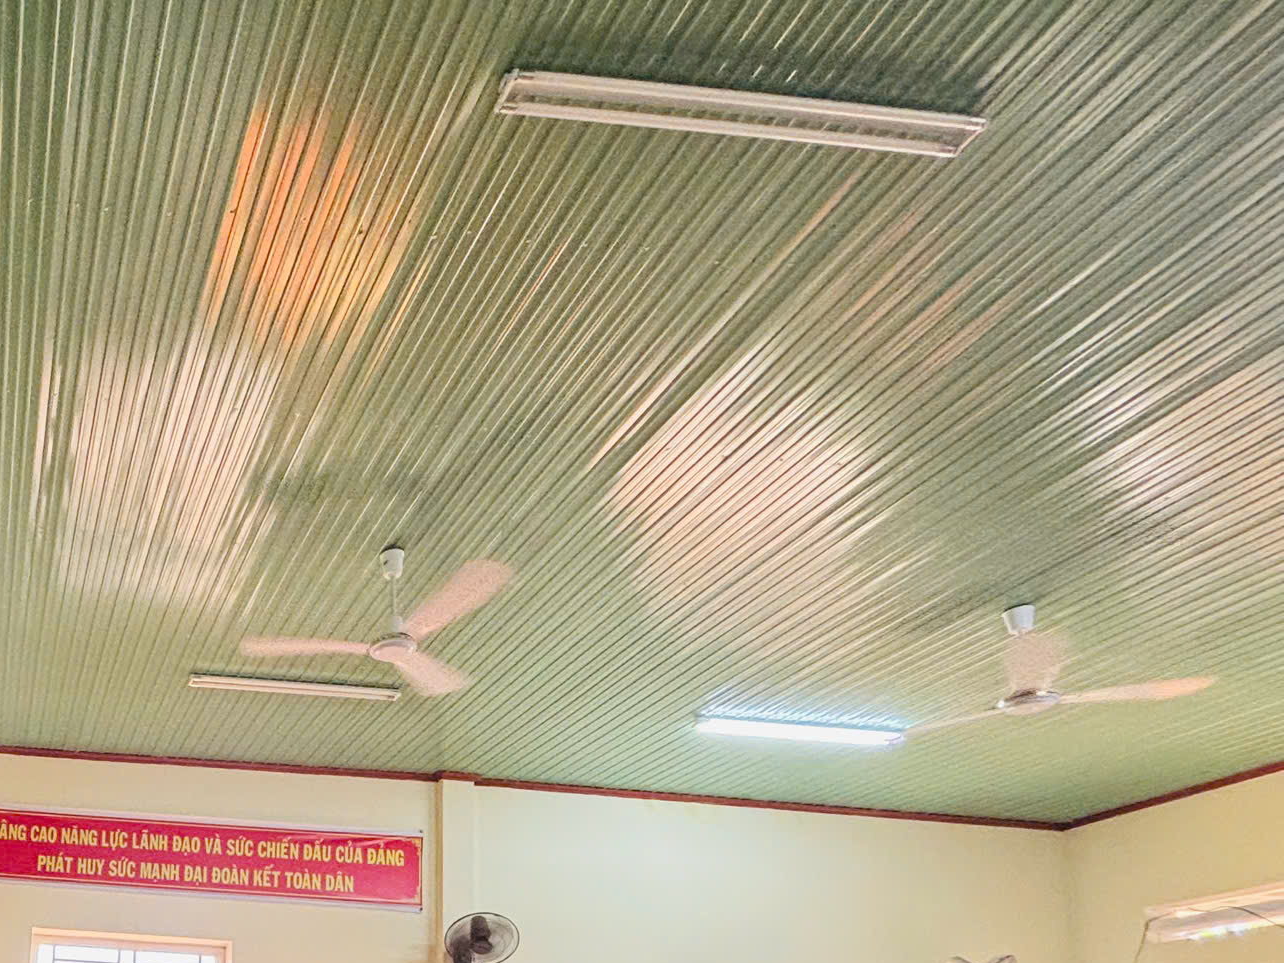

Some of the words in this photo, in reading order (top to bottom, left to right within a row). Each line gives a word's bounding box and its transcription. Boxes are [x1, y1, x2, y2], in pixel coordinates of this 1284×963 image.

[30, 825, 58, 844] CAO
[61, 825, 98, 847] NĂNG
[101, 828, 128, 850] LỰC
[132, 829, 168, 851] LÃNH
[172, 836, 201, 856] ĐẠO
[204, 833, 222, 855] VÀ
[226, 834, 254, 857] SỨC
[257, 836, 300, 860] CHIẾN
[303, 838, 331, 862] ĐẤU
[335, 840, 364, 864] CỦA
[367, 841, 405, 867] ĐẢNG
[37, 852, 74, 873] PHÁT
[77, 858, 105, 876] HUY
[108, 856, 136, 878] SỨC
[139, 861, 180, 882] MẠNH
[184, 866, 208, 886] ĐẠI
[211, 864, 249, 886] ĐOÀN
[253, 863, 281, 889] KẾT
[285, 868, 322, 890] TOÀN
[325, 871, 354, 893] DÂN
